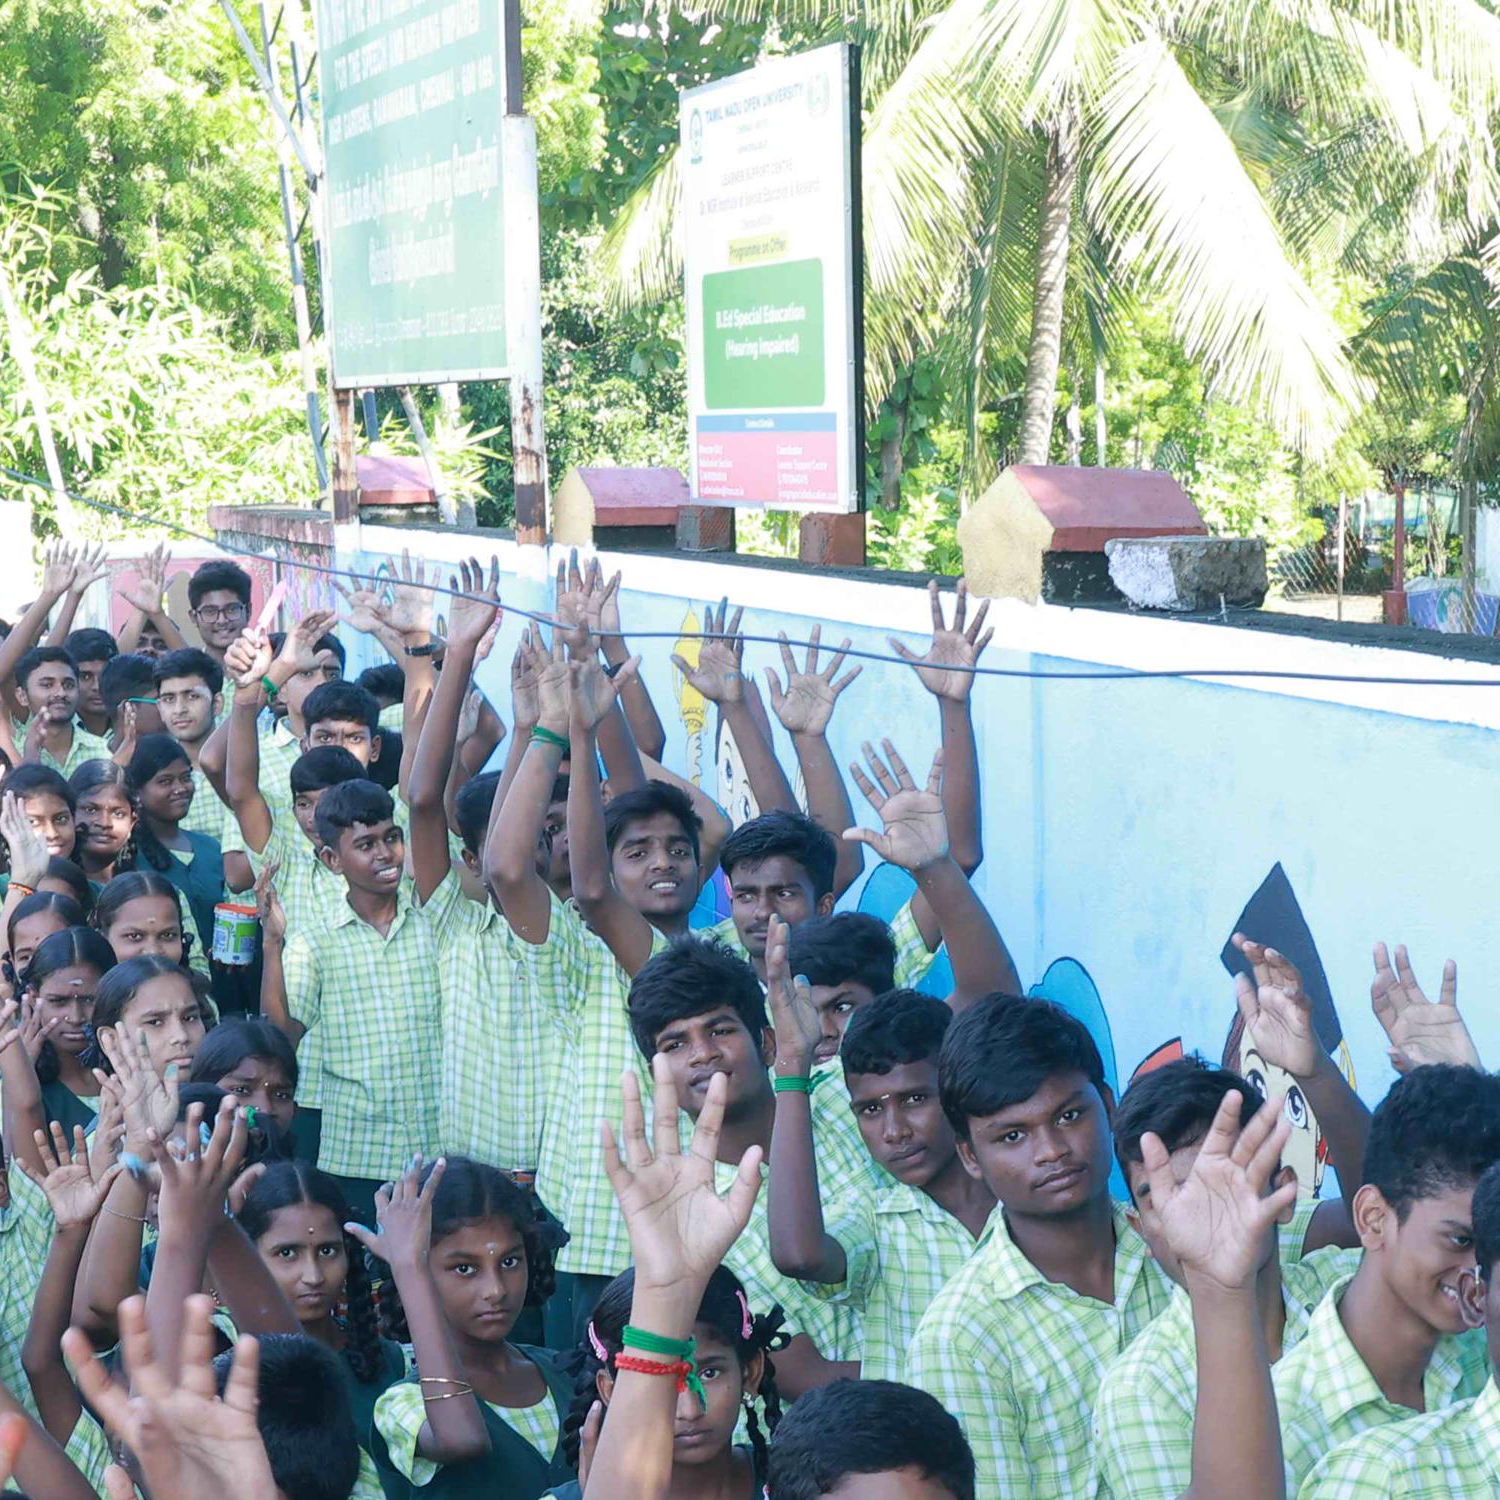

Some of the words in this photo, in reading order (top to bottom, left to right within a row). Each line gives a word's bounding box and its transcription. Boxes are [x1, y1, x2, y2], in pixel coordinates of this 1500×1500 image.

[733, 306, 762, 330] Special
[763, 302, 806, 325] Education
[725, 337, 758, 360] (Hearing
